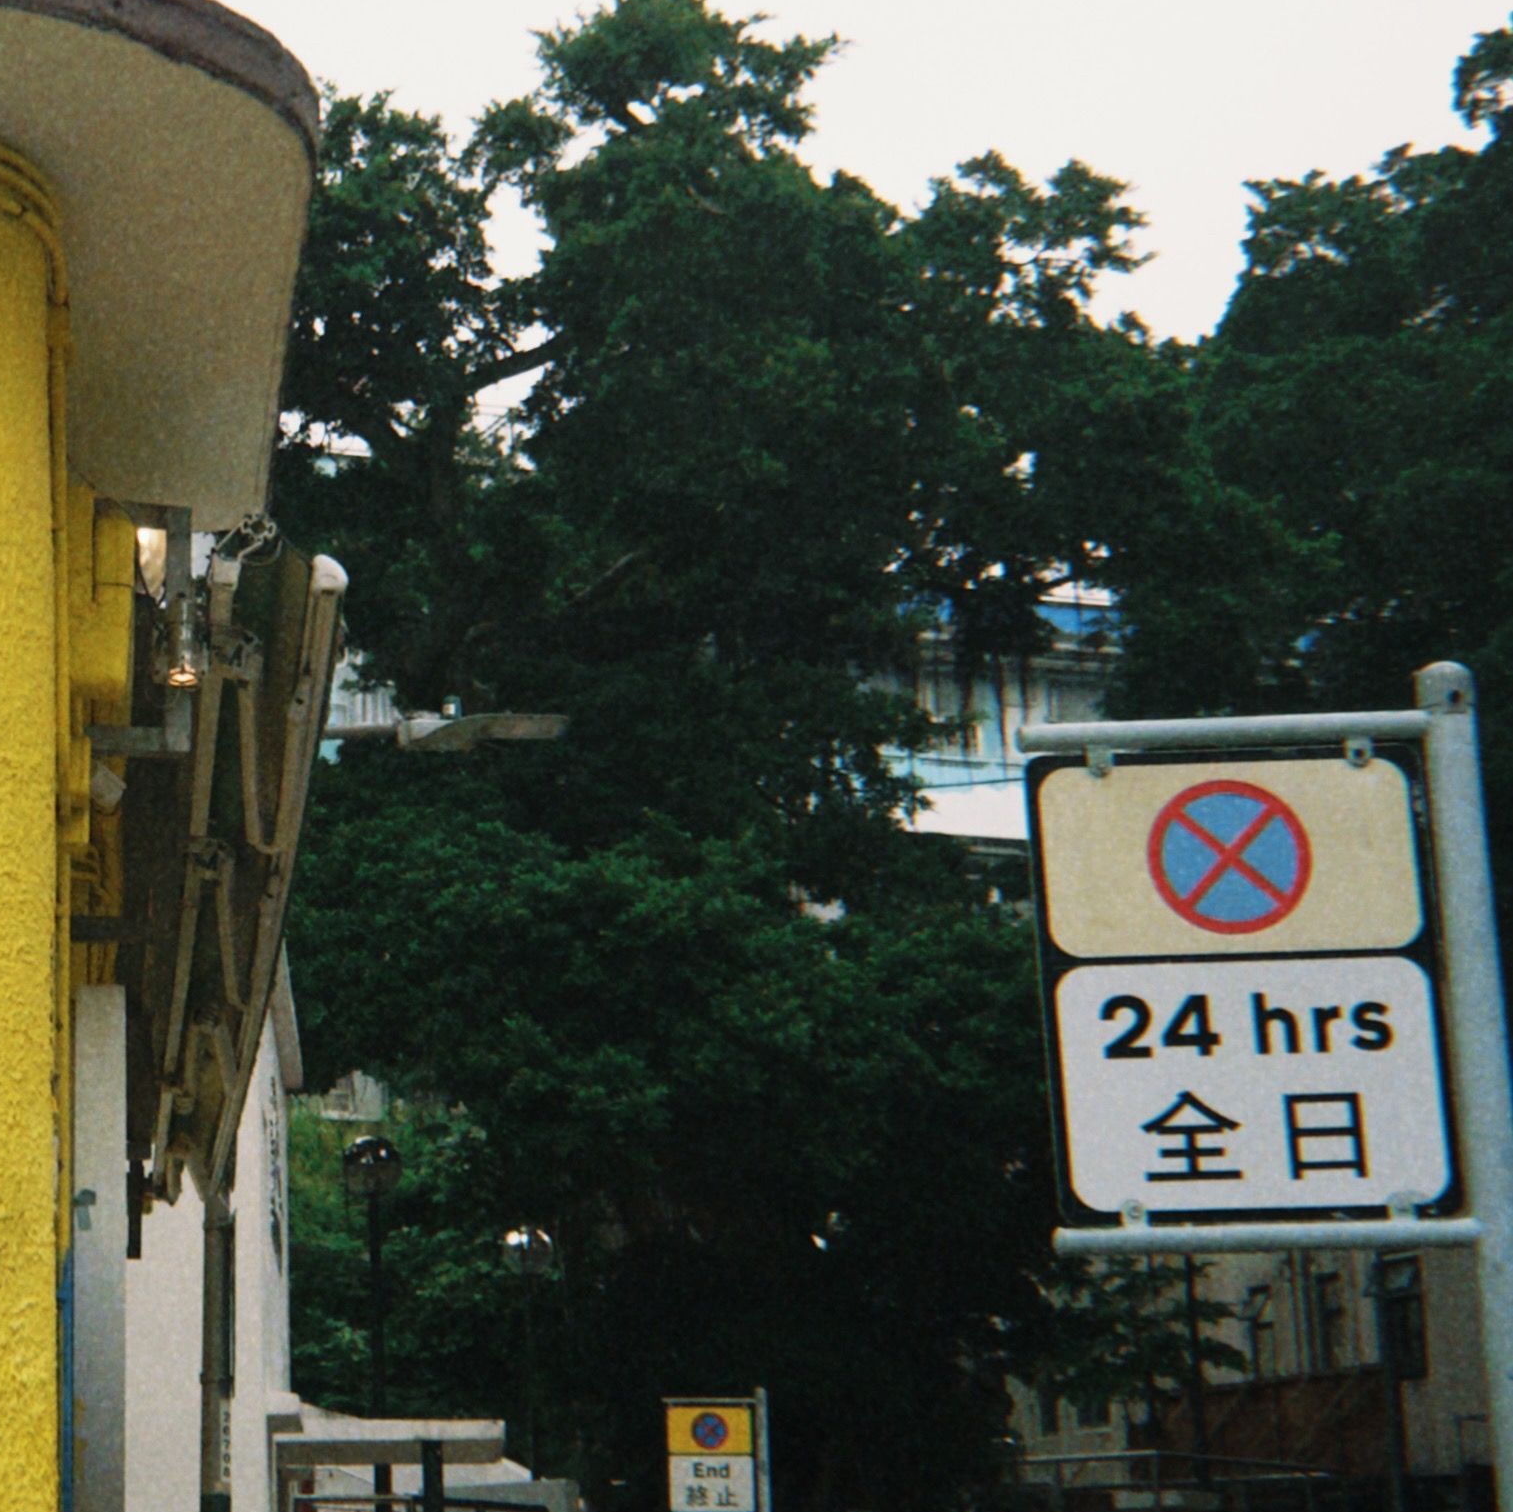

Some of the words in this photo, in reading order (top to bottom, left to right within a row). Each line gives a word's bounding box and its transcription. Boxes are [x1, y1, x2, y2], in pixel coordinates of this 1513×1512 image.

[1099, 993, 1222, 1060] 24
[1249, 991, 1395, 1056] hrs
[1140, 1089, 1369, 1183] 全日
[693, 1462, 730, 1478] End
